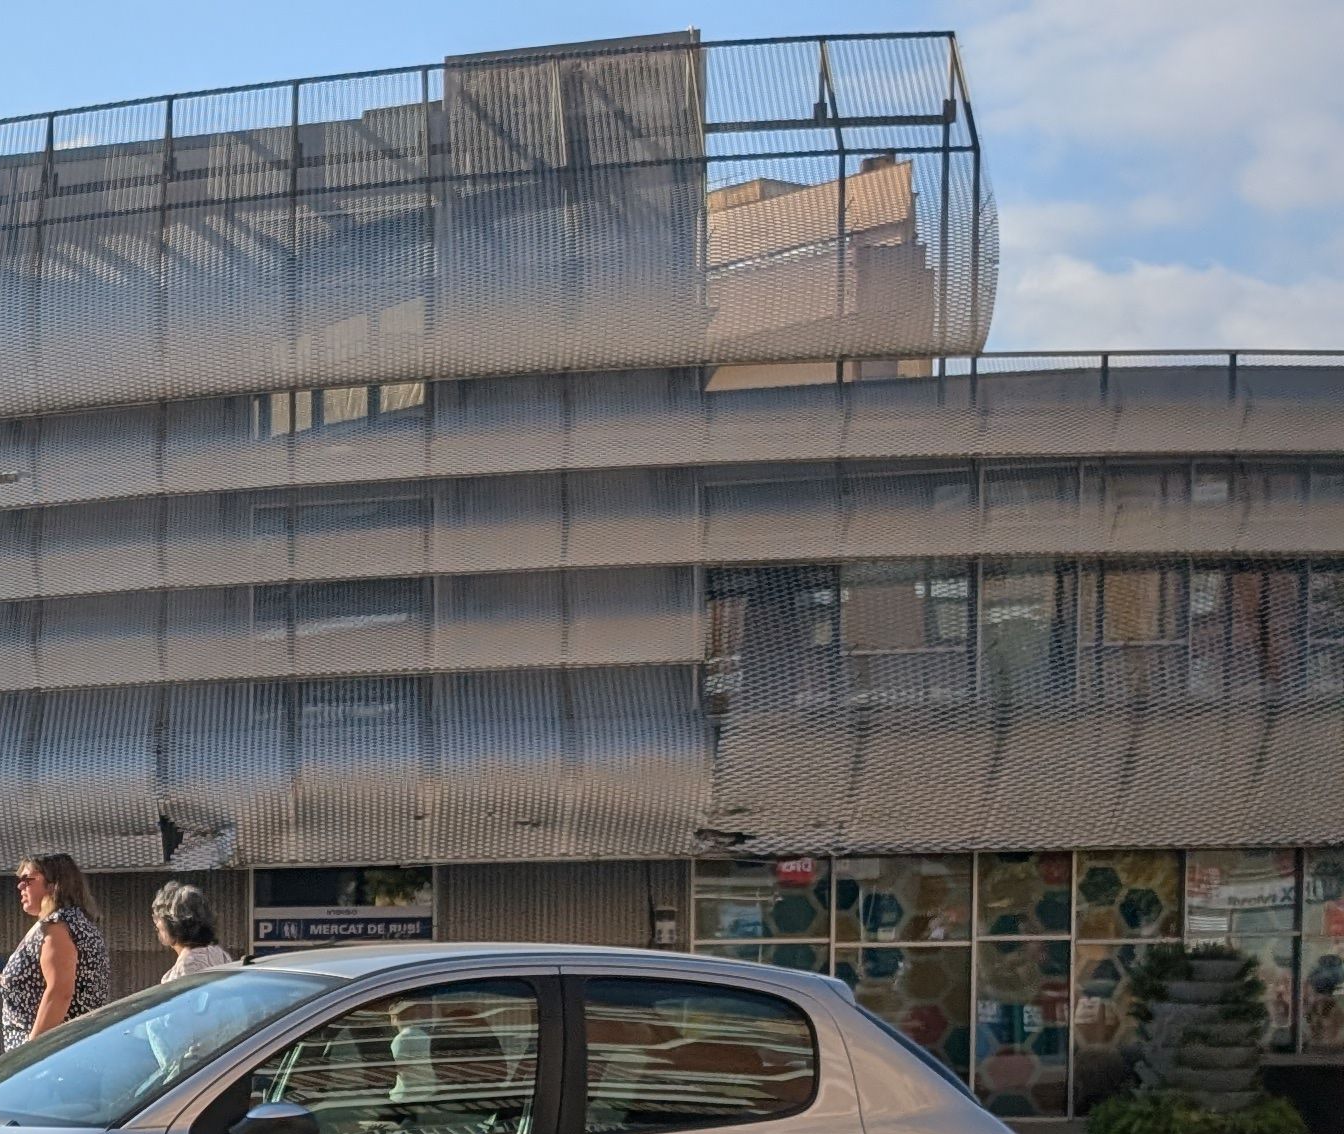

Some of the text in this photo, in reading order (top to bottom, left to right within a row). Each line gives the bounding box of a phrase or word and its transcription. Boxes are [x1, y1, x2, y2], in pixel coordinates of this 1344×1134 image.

[259, 922, 273, 938] P
[309, 923, 363, 935] MERCAT
[368, 922, 385, 935] DE
